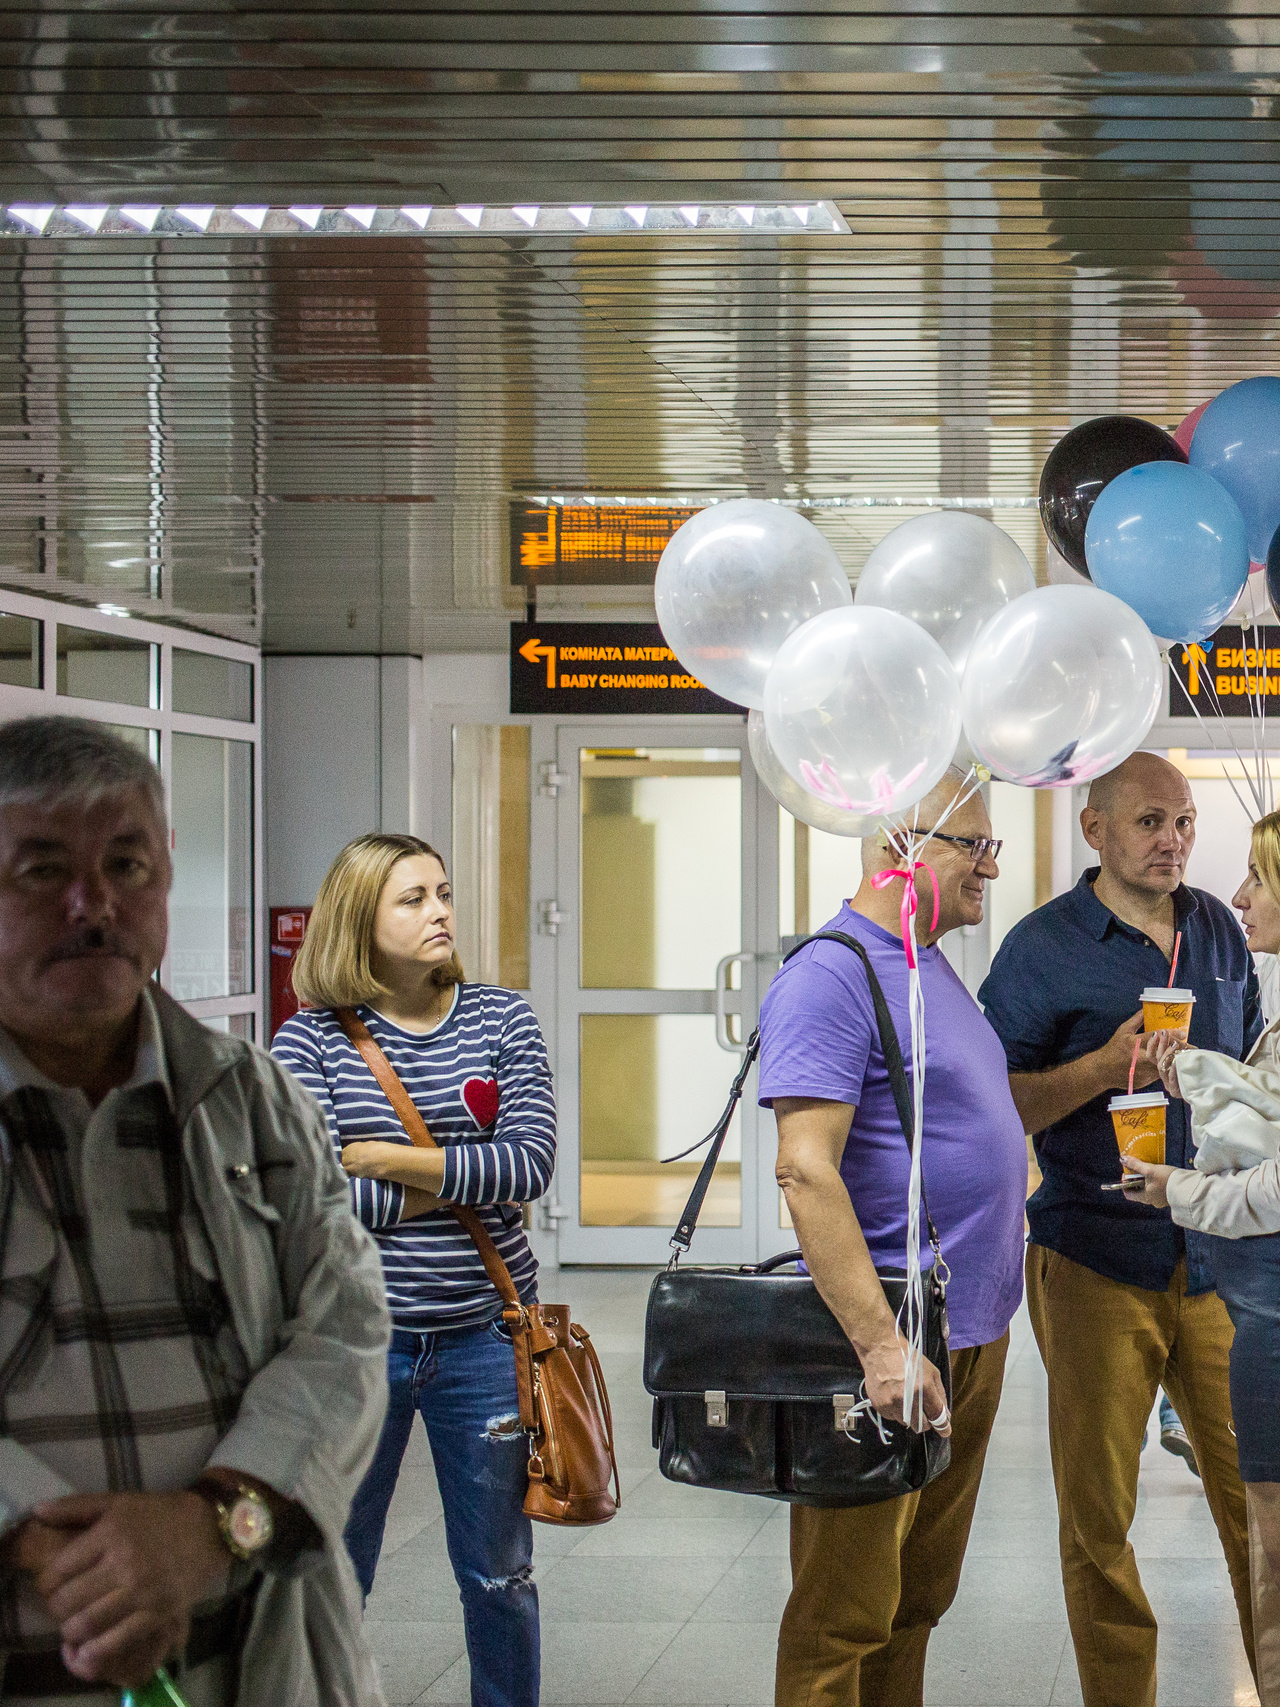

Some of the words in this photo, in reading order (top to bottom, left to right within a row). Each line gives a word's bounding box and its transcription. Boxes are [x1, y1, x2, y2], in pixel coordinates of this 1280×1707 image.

[560, 647, 623, 661] КОМНАТА
[560, 675, 598, 688] BABY
[599, 675, 669, 688] CHANGING
